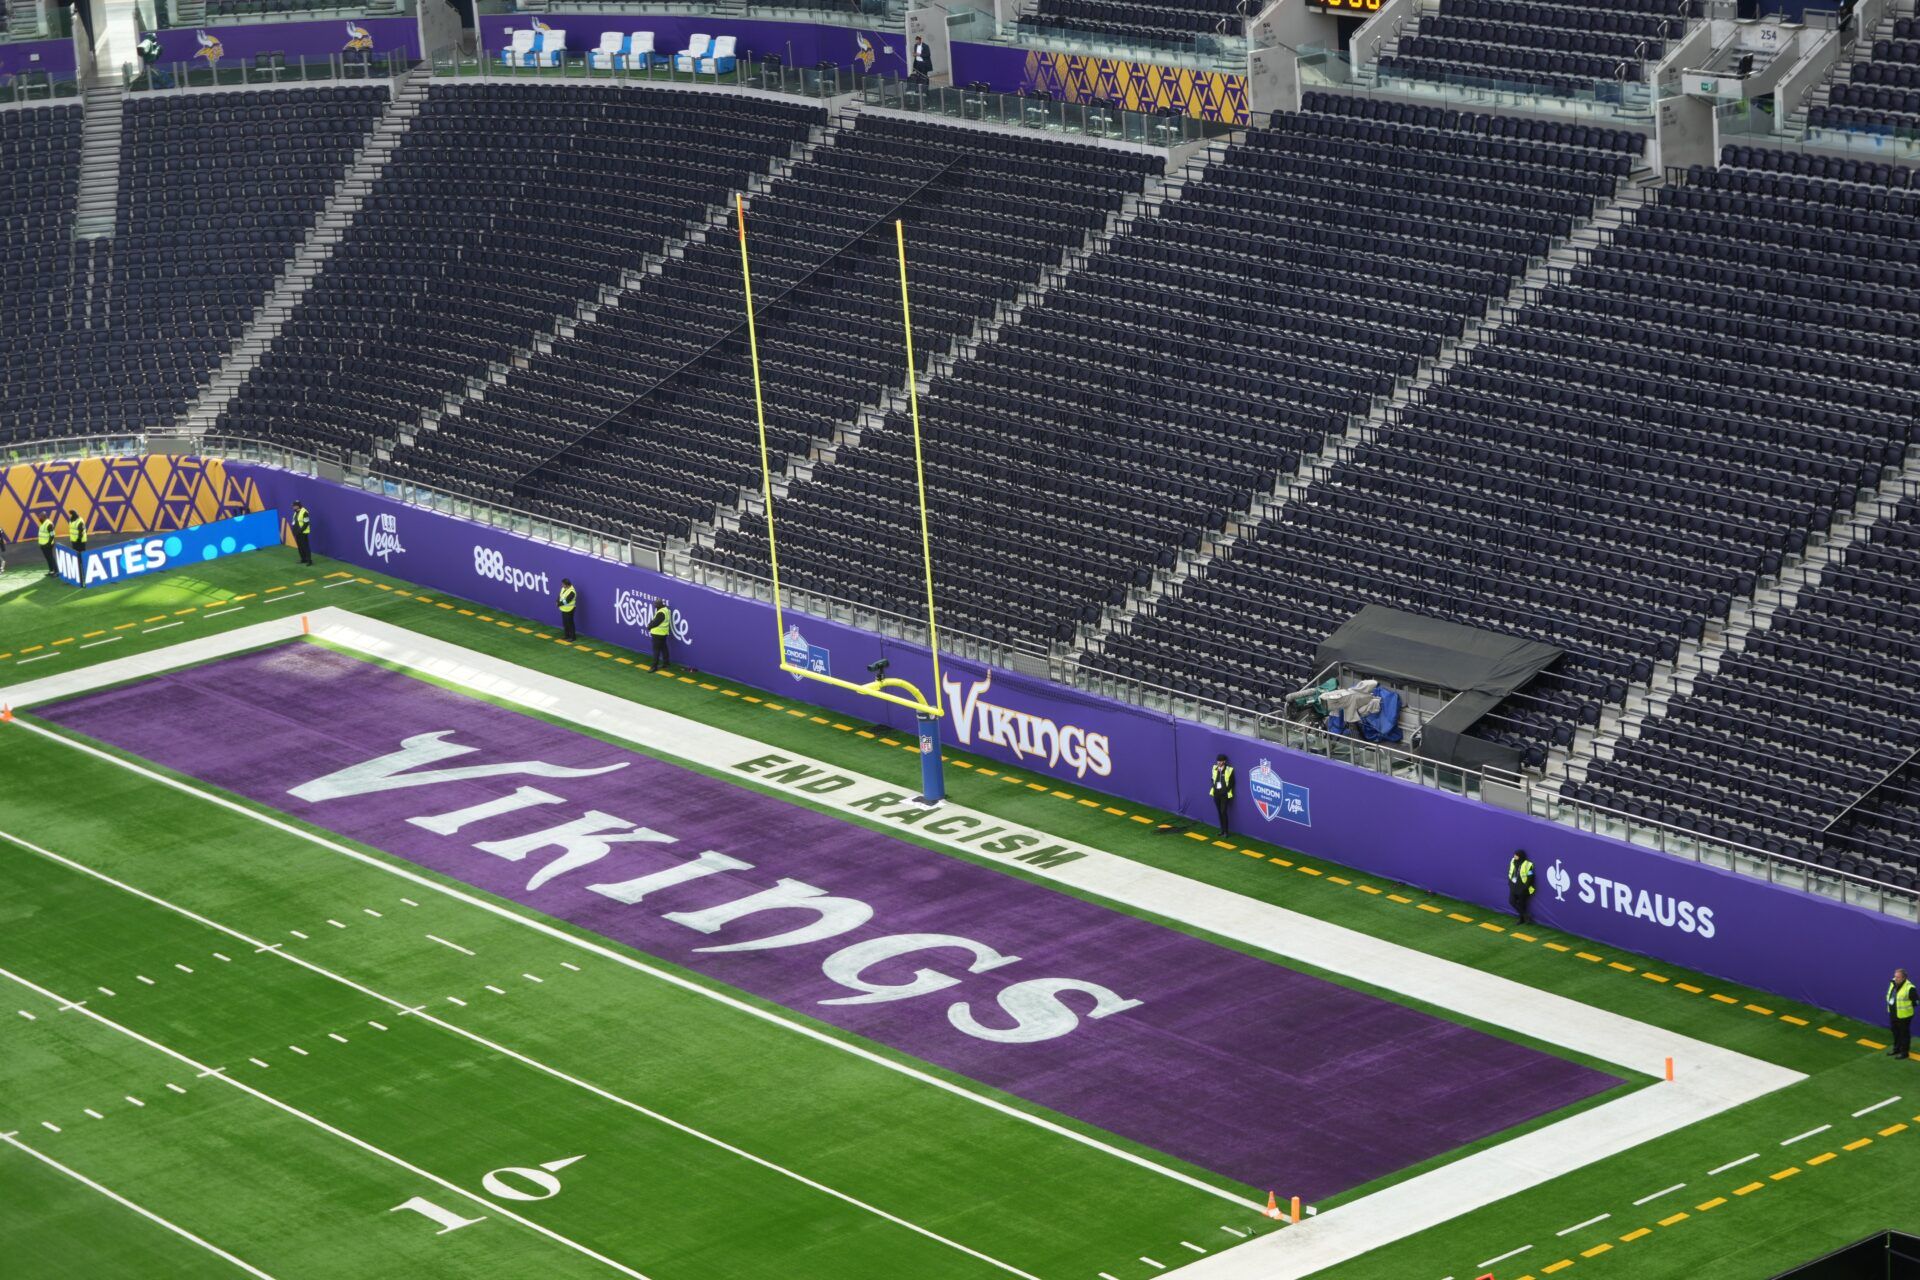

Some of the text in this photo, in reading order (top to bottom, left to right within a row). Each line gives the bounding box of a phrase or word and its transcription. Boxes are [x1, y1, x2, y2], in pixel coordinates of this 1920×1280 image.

[1761, 30, 1777, 40] 254
[356, 513, 406, 563] Vegas
[473, 545, 549, 595] 888sport
[614, 587, 692, 645] Kissiee
[731, 754, 1088, 870] END RACISM
[1252, 783, 1280, 799] LONDON
[1577, 872, 1716, 939] STRAUSS
